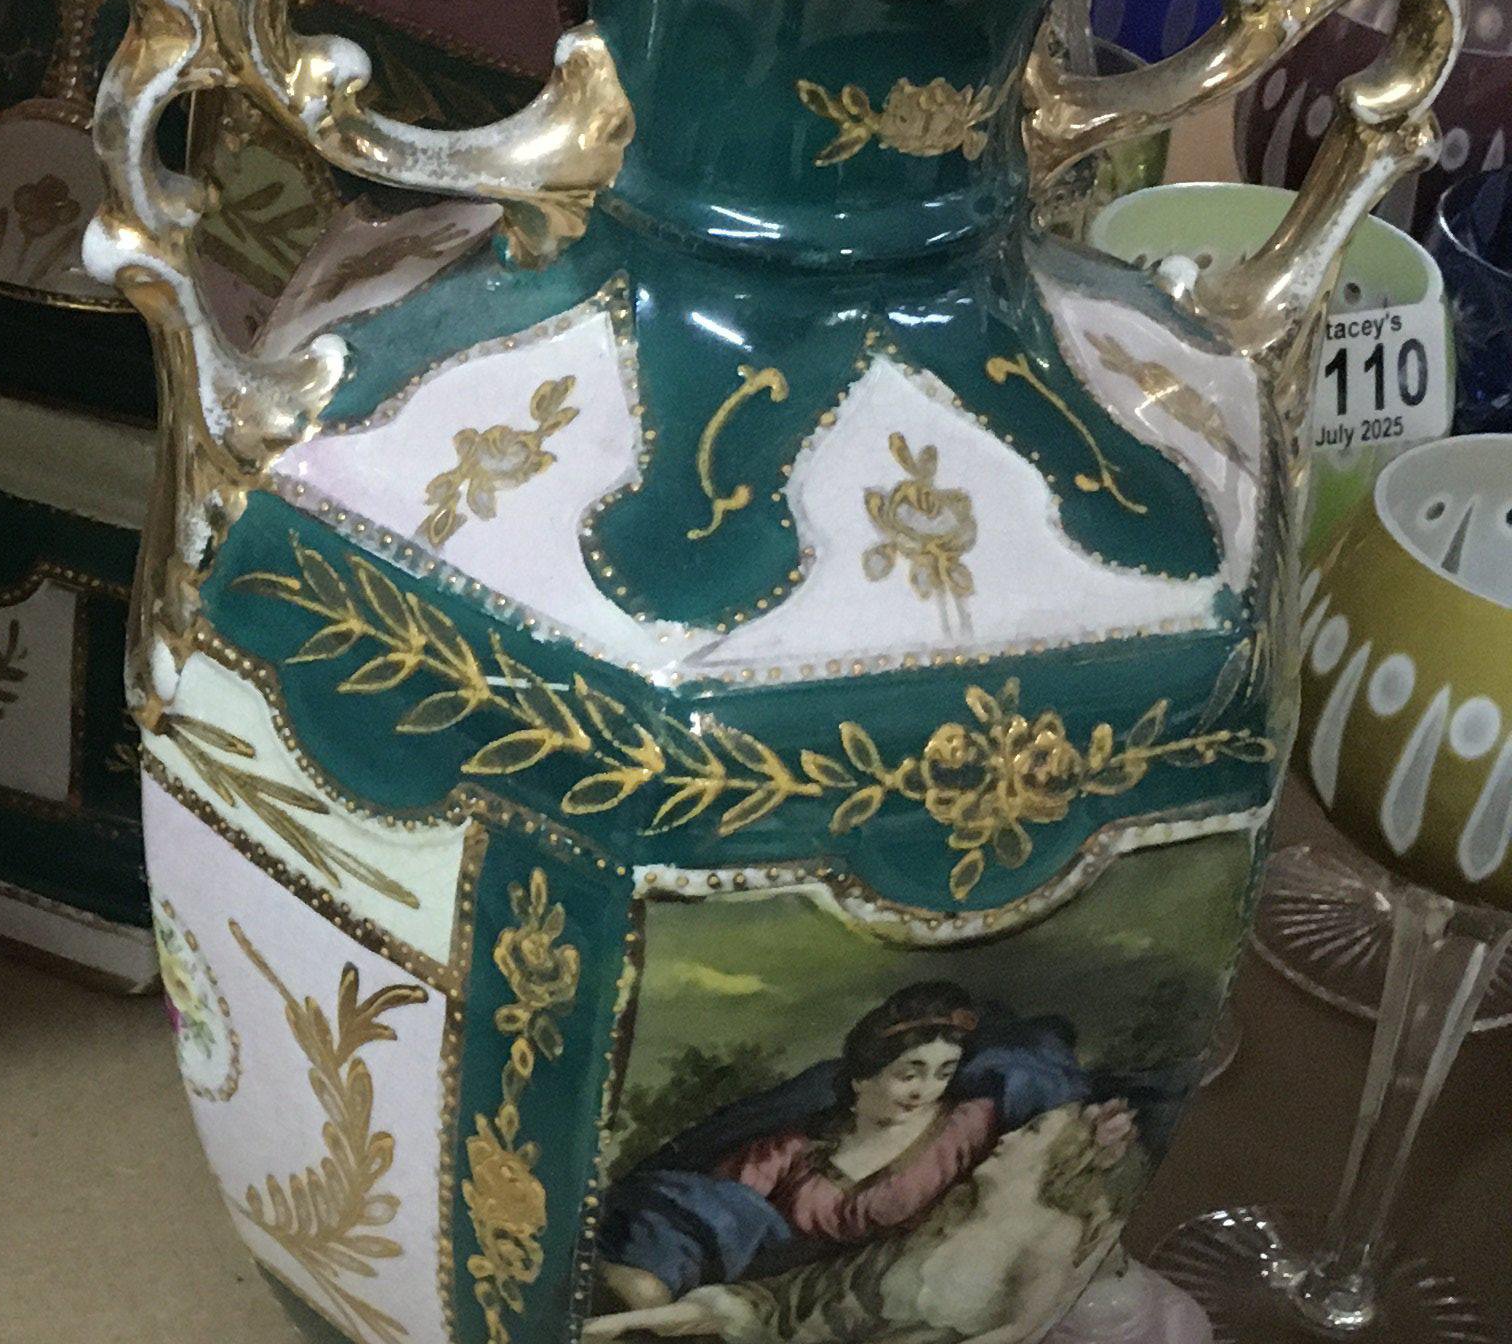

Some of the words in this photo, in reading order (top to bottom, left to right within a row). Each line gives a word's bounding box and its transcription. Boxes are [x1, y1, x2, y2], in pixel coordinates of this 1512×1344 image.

[1325, 312, 1403, 340] tacey's
[1325, 338, 1428, 416] 110
[1314, 423, 1355, 449] July
[1360, 416, 1404, 442] 2025
